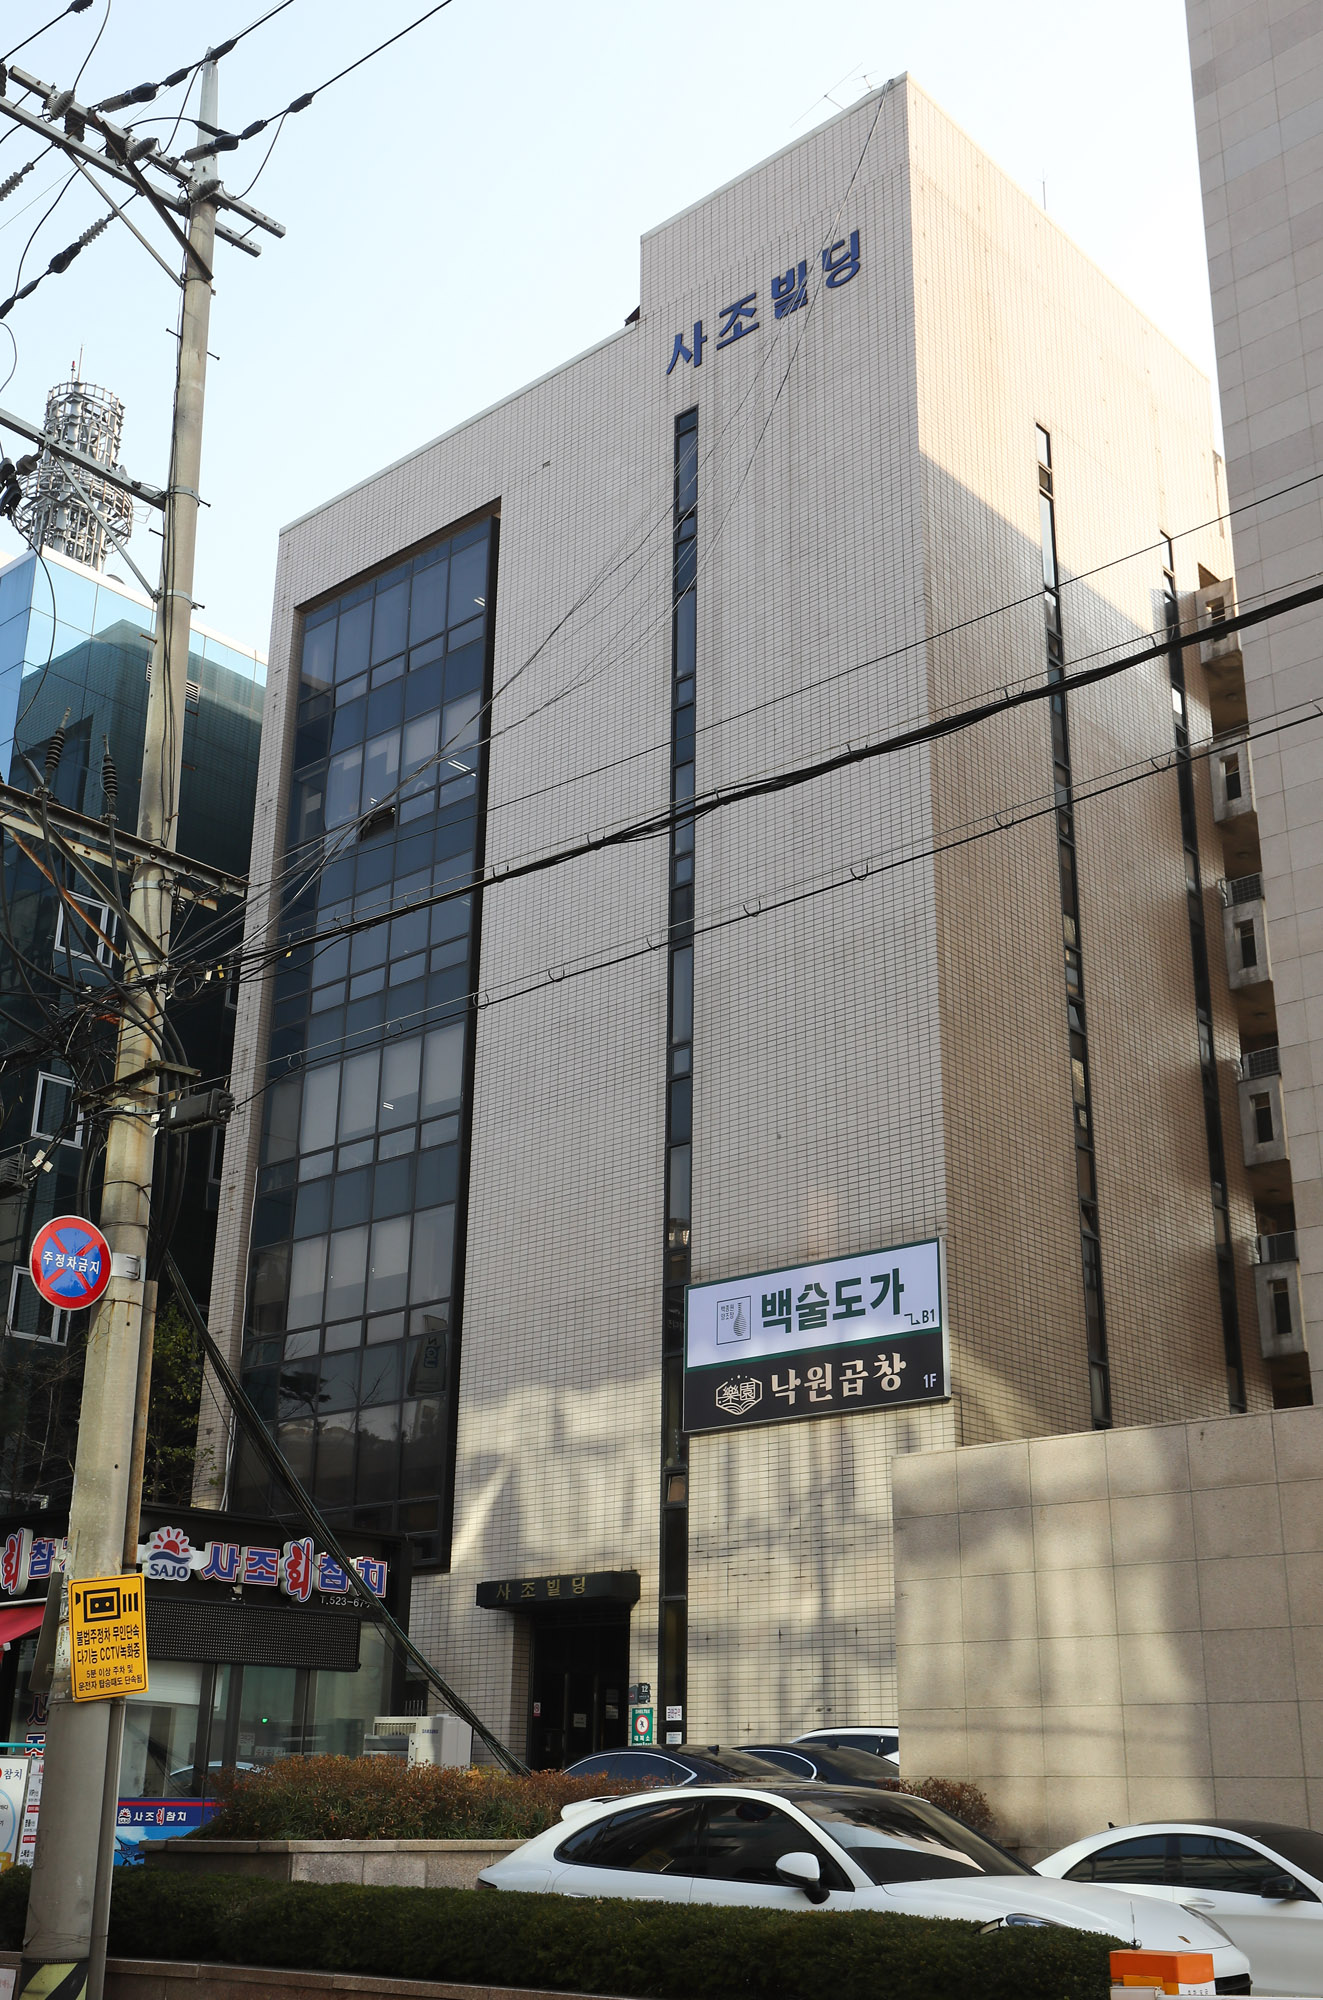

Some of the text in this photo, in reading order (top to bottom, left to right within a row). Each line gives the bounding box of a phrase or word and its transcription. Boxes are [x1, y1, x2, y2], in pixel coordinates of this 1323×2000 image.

[666, 229, 861, 375] 사조빌딩
[43, 1250, 100, 1275] 주정차금지
[761, 1267, 905, 1334] 백술도가
[921, 1308, 936, 1324] B1
[771, 1352, 907, 1405] 낙원곱창
[923, 1372, 937, 1388] 1F
[150, 1563, 188, 1578] SAJO
[496, 1576, 586, 1600] 사조빌딩
[77, 1624, 139, 1646] 불법주정차 무인단속
[77, 1642, 140, 1665] 다기능 CCTV녹화중
[99, 1667, 111, 1677] 이상
[113, 1665, 125, 1675] 주차
[78, 1680, 97, 1691] 운전자
